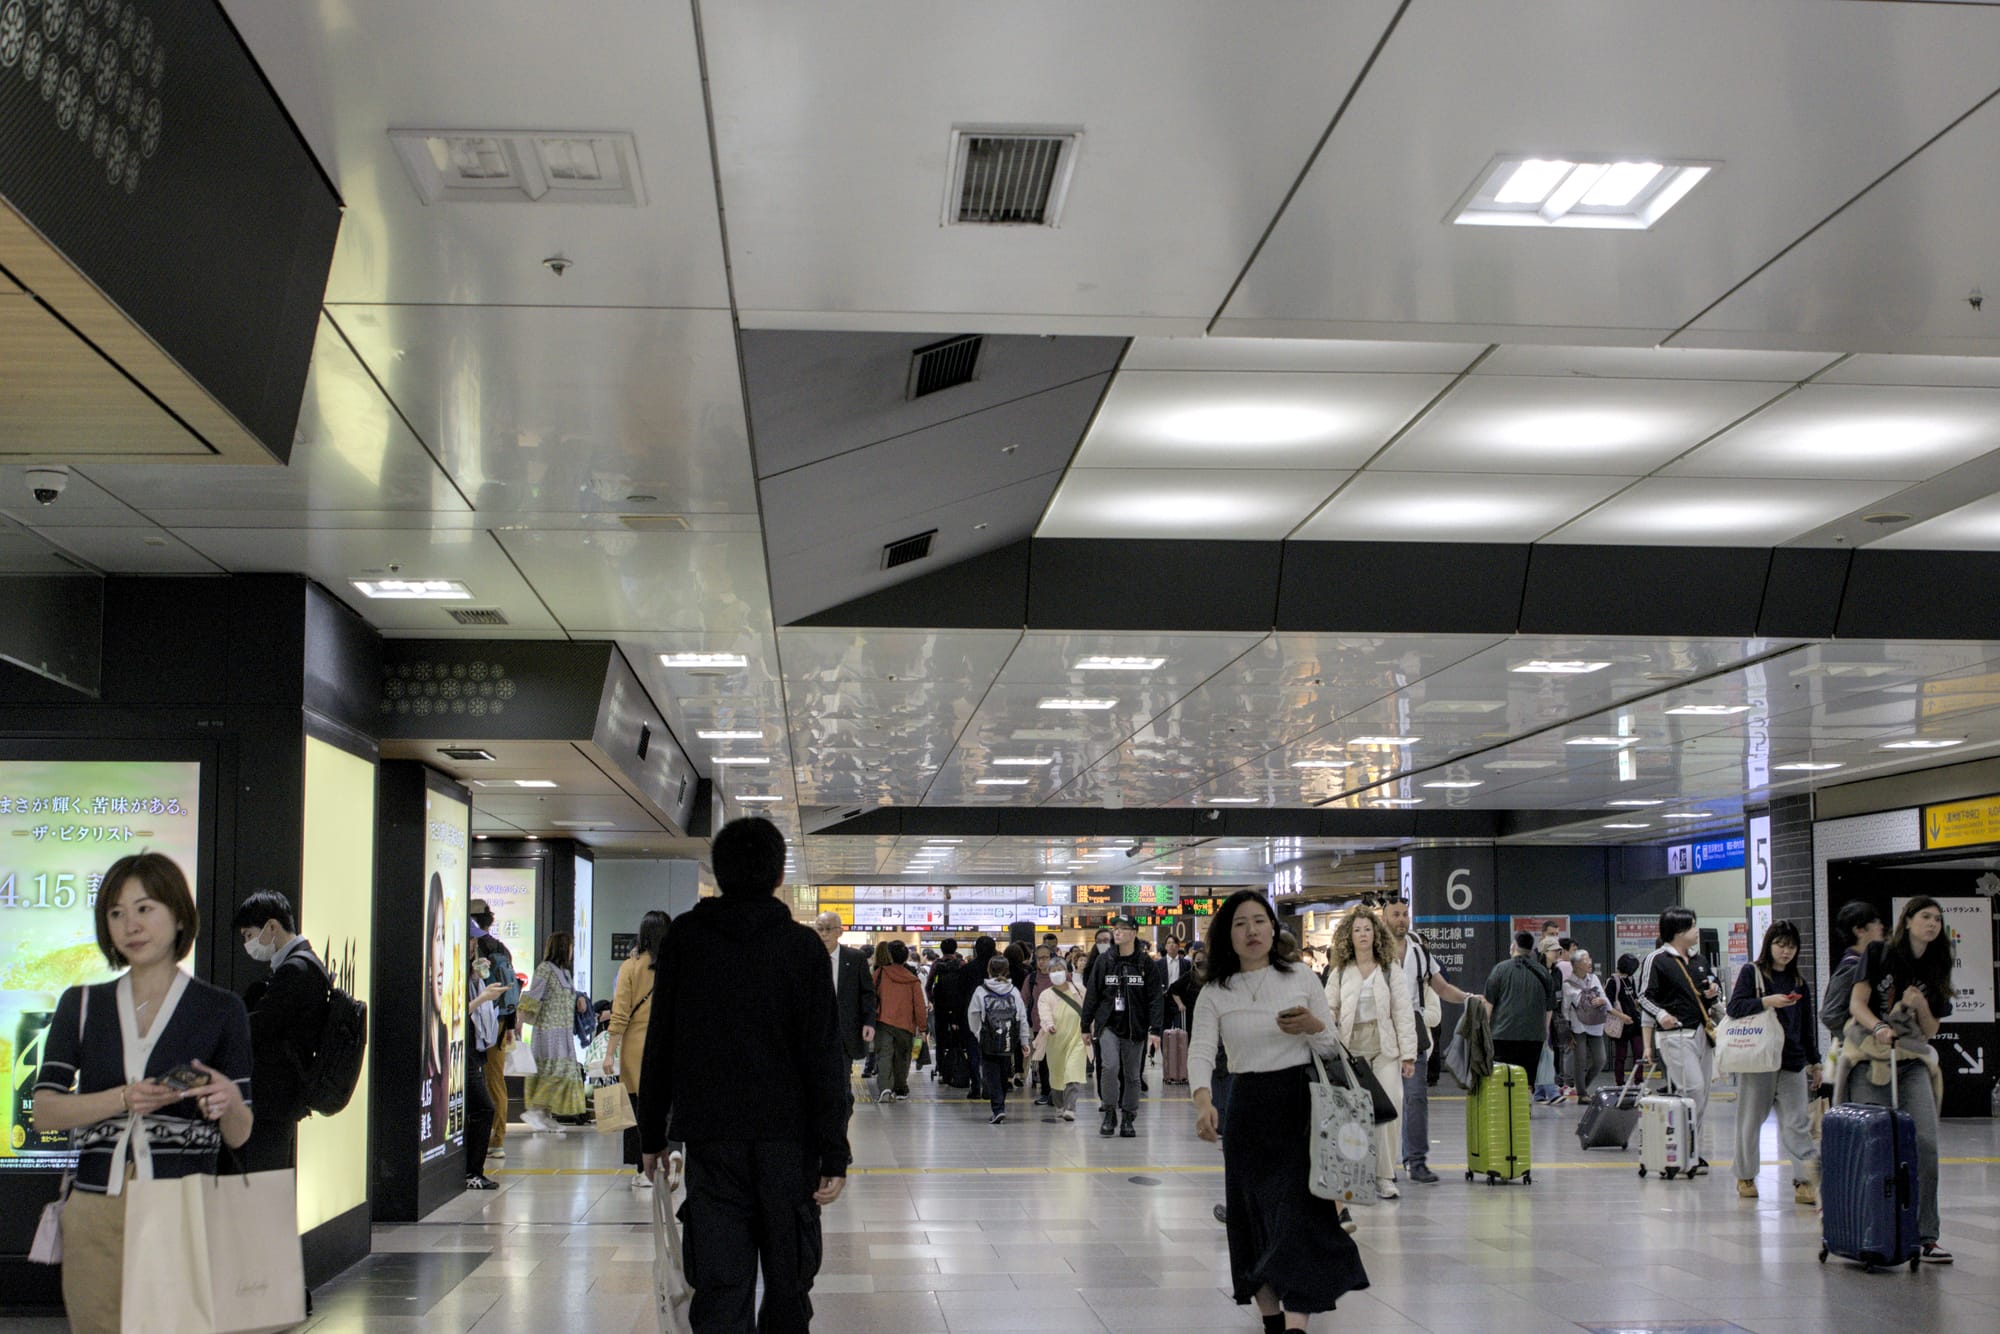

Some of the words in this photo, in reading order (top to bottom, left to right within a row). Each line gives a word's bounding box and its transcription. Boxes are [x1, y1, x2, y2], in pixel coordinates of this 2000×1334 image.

[32, 825, 134, 841] ザ・ビタリスト
[1695, 845, 1702, 869] 6
[1757, 837, 1768, 891] 5
[0, 872, 76, 908] 4.15
[1446, 868, 1473, 911] 6
[1451, 942, 1467, 950] Line
[1433, 954, 1464, 965] 内方面
[1956, 1001, 1985, 1009] レストラン
[1726, 1026, 1764, 1036] rainbow
